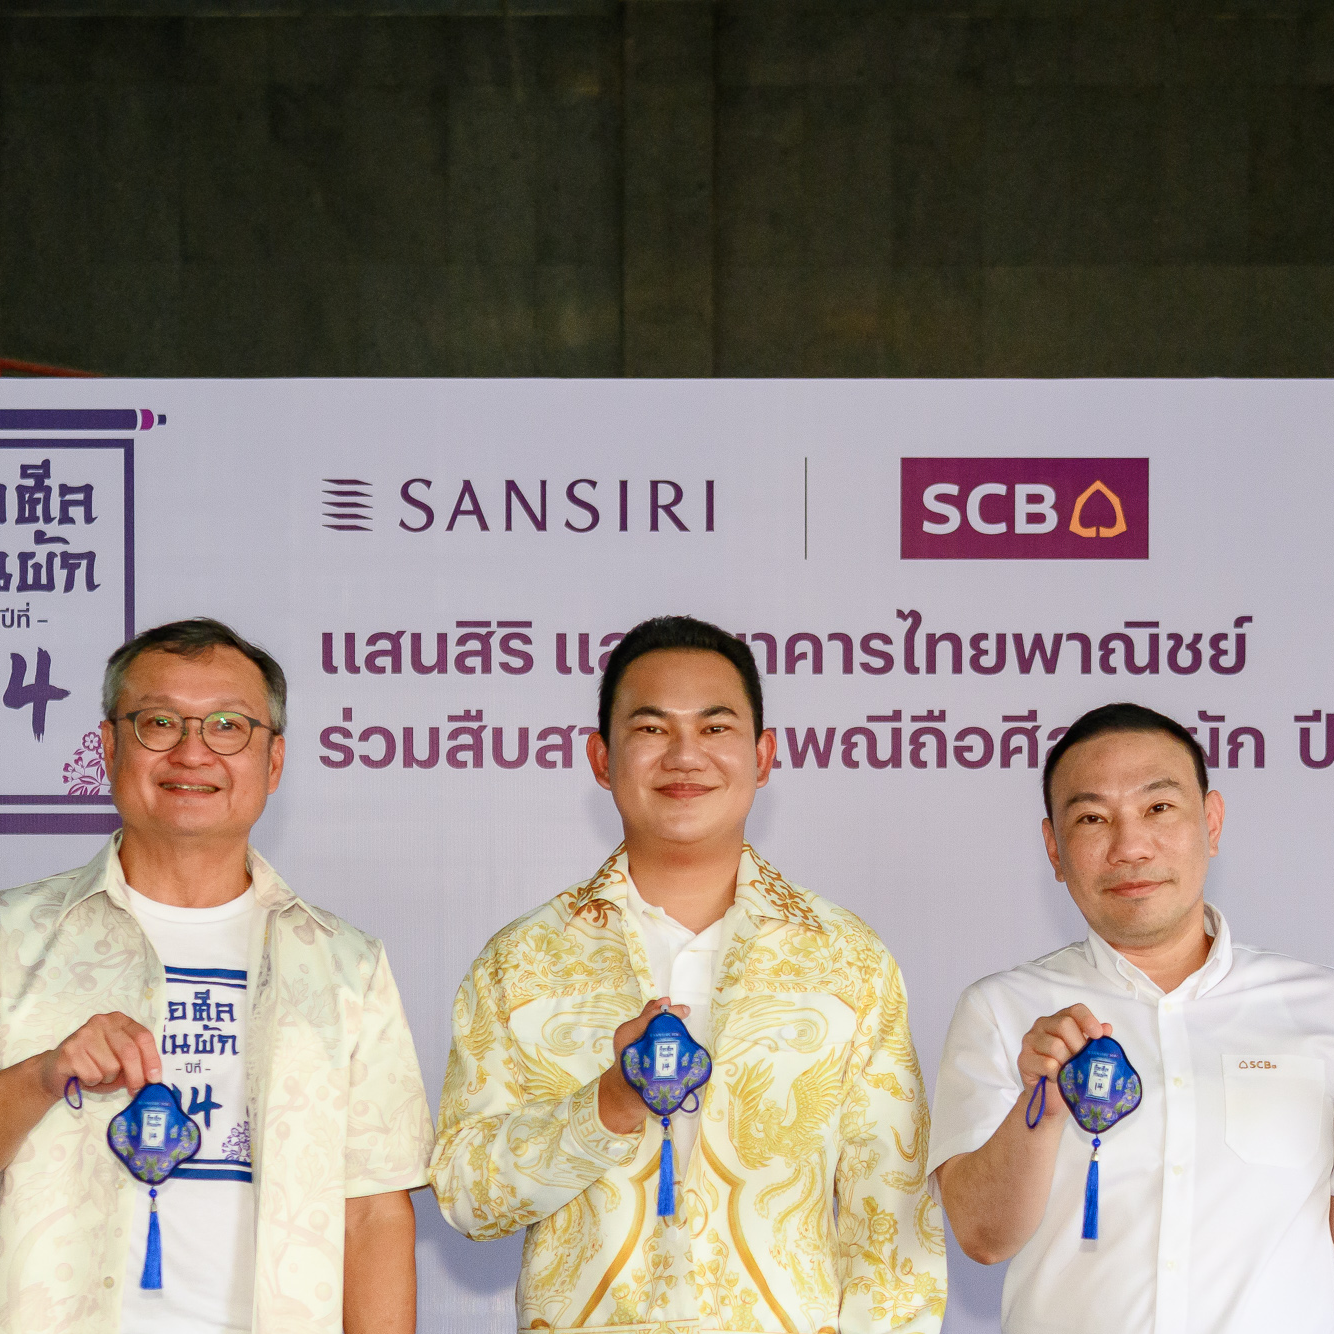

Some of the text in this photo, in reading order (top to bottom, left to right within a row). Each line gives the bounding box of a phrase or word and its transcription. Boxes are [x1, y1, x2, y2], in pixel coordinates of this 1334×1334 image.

[399, 478, 716, 534] SANSIRI
[923, 483, 1059, 536] SCB
[322, 620, 535, 677] แสนสิริ
[165, 989, 237, 1023] อศีล
